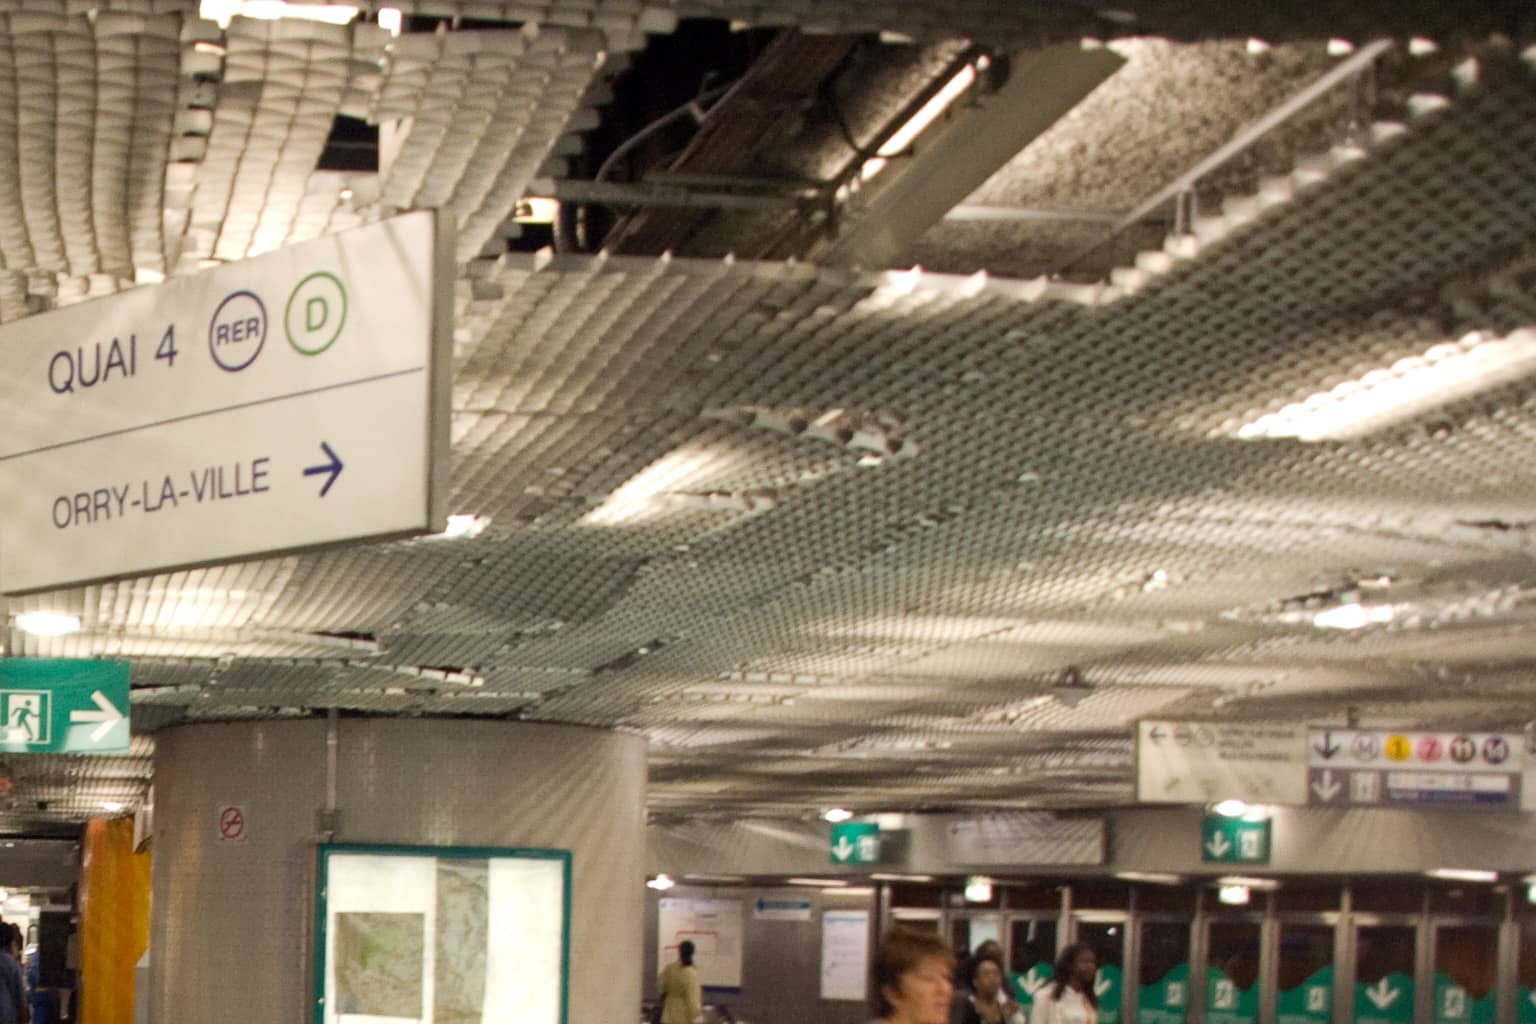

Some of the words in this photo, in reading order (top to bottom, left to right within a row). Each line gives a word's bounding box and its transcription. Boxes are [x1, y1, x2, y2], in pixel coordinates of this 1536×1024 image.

[48, 334, 137, 394] QUAI
[155, 323, 178, 367] 4
[216, 317, 260, 346] RER
[306, 297, 328, 332] D
[52, 457, 271, 529] ORRY-LA-VILLE
